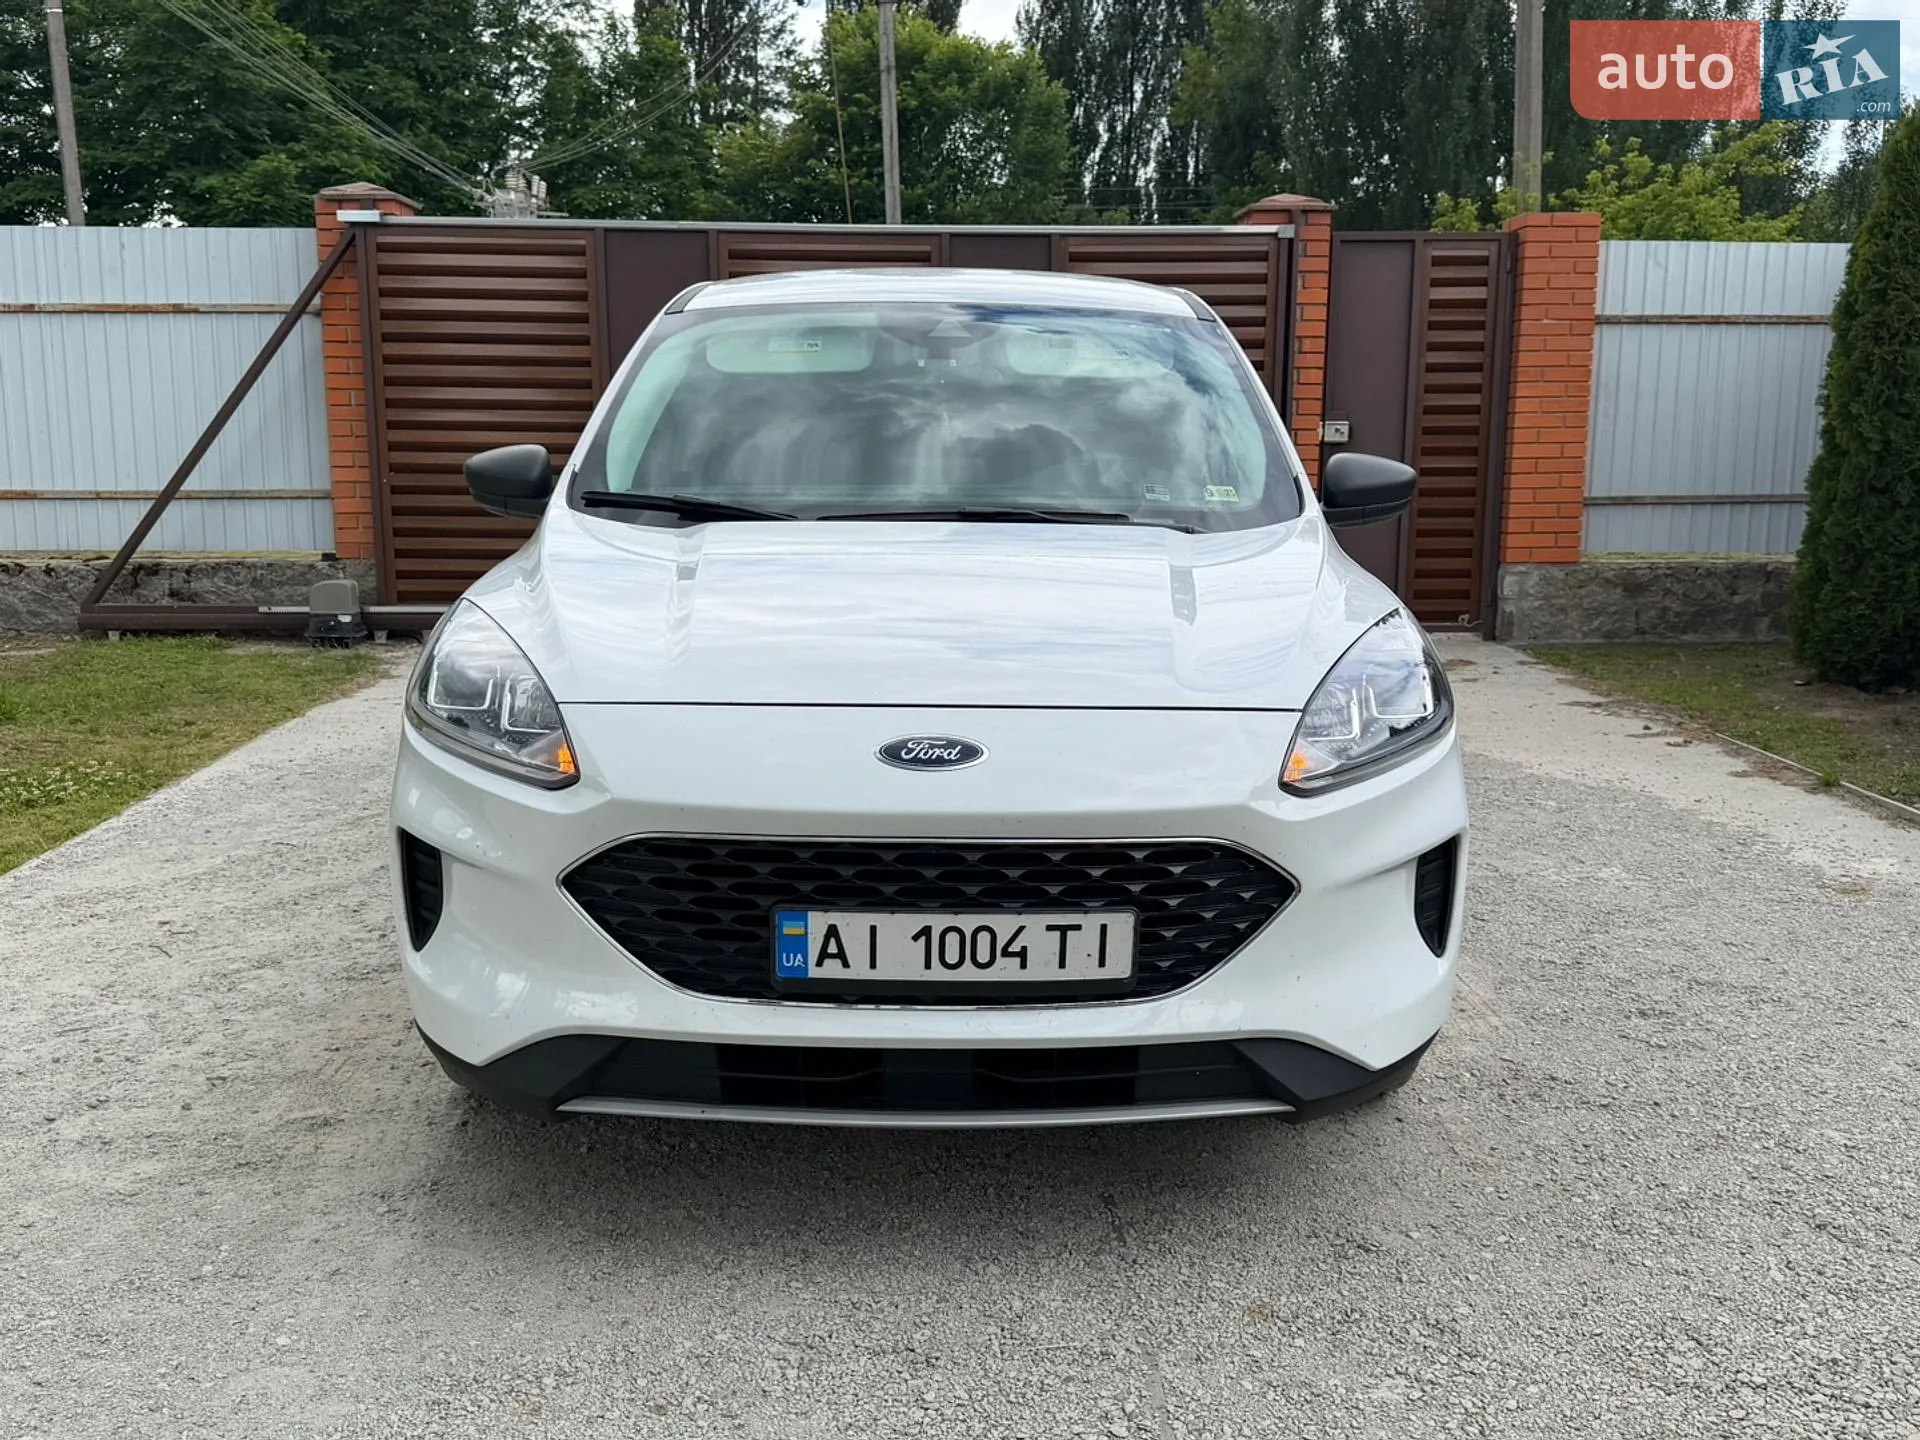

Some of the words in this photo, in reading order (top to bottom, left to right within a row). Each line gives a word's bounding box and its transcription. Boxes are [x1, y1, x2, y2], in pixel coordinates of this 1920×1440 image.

[901, 740, 962, 760] Ford
[815, 923, 877, 970] AI
[911, 924, 1028, 970] 1004
[1045, 923, 1108, 970] TI
[782, 953, 806, 967] UA
